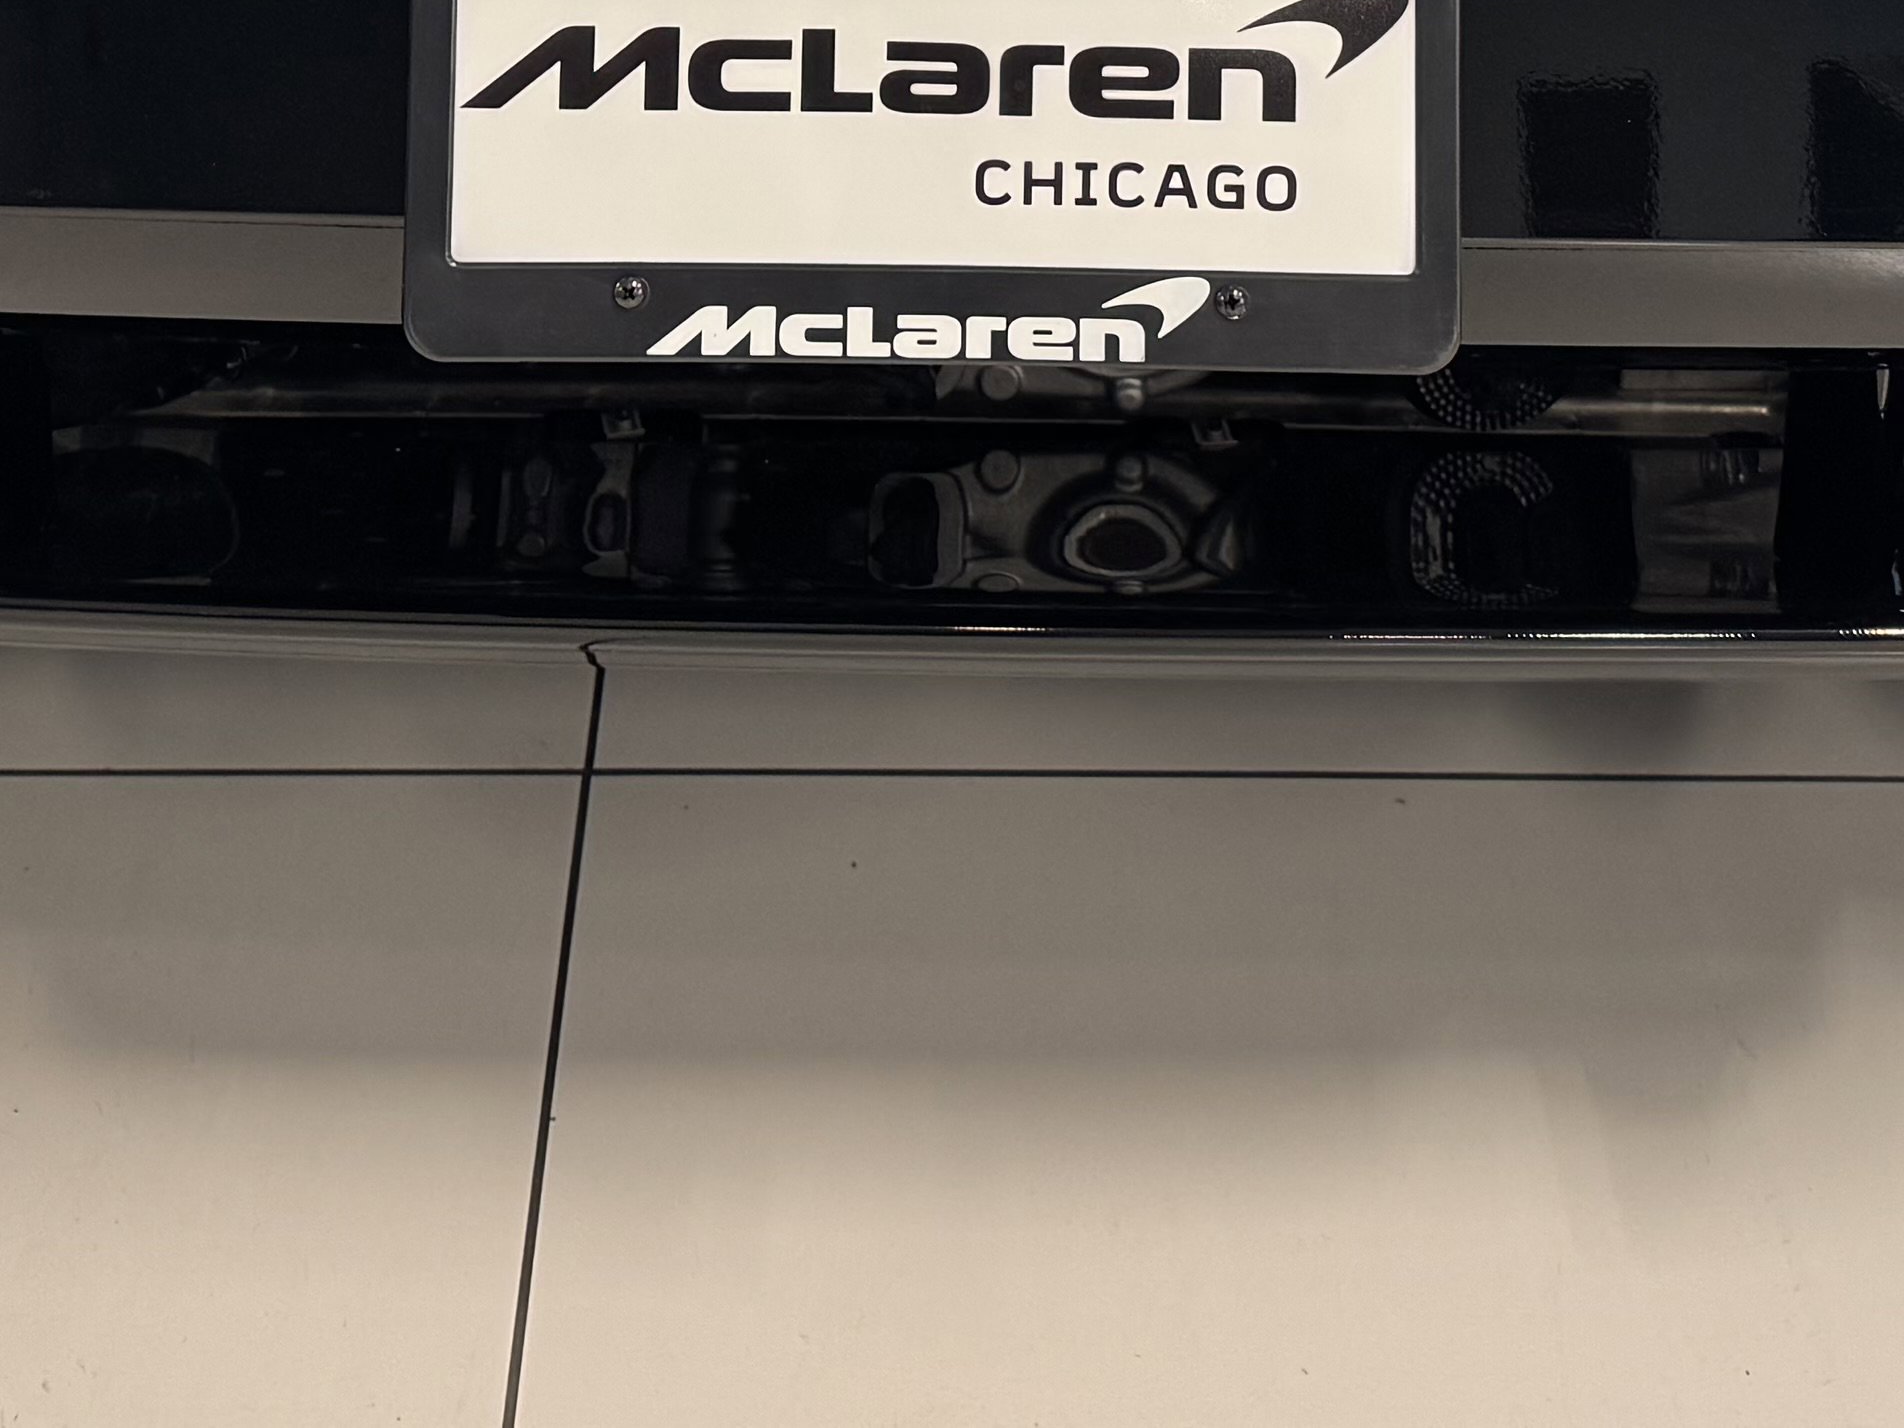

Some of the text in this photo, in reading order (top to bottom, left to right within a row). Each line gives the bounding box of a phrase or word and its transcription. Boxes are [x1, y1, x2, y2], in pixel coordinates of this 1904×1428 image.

[460, 25, 1297, 123] McLaren
[974, 159, 1299, 212] CHICAGO
[645, 305, 1147, 363] McLaren
